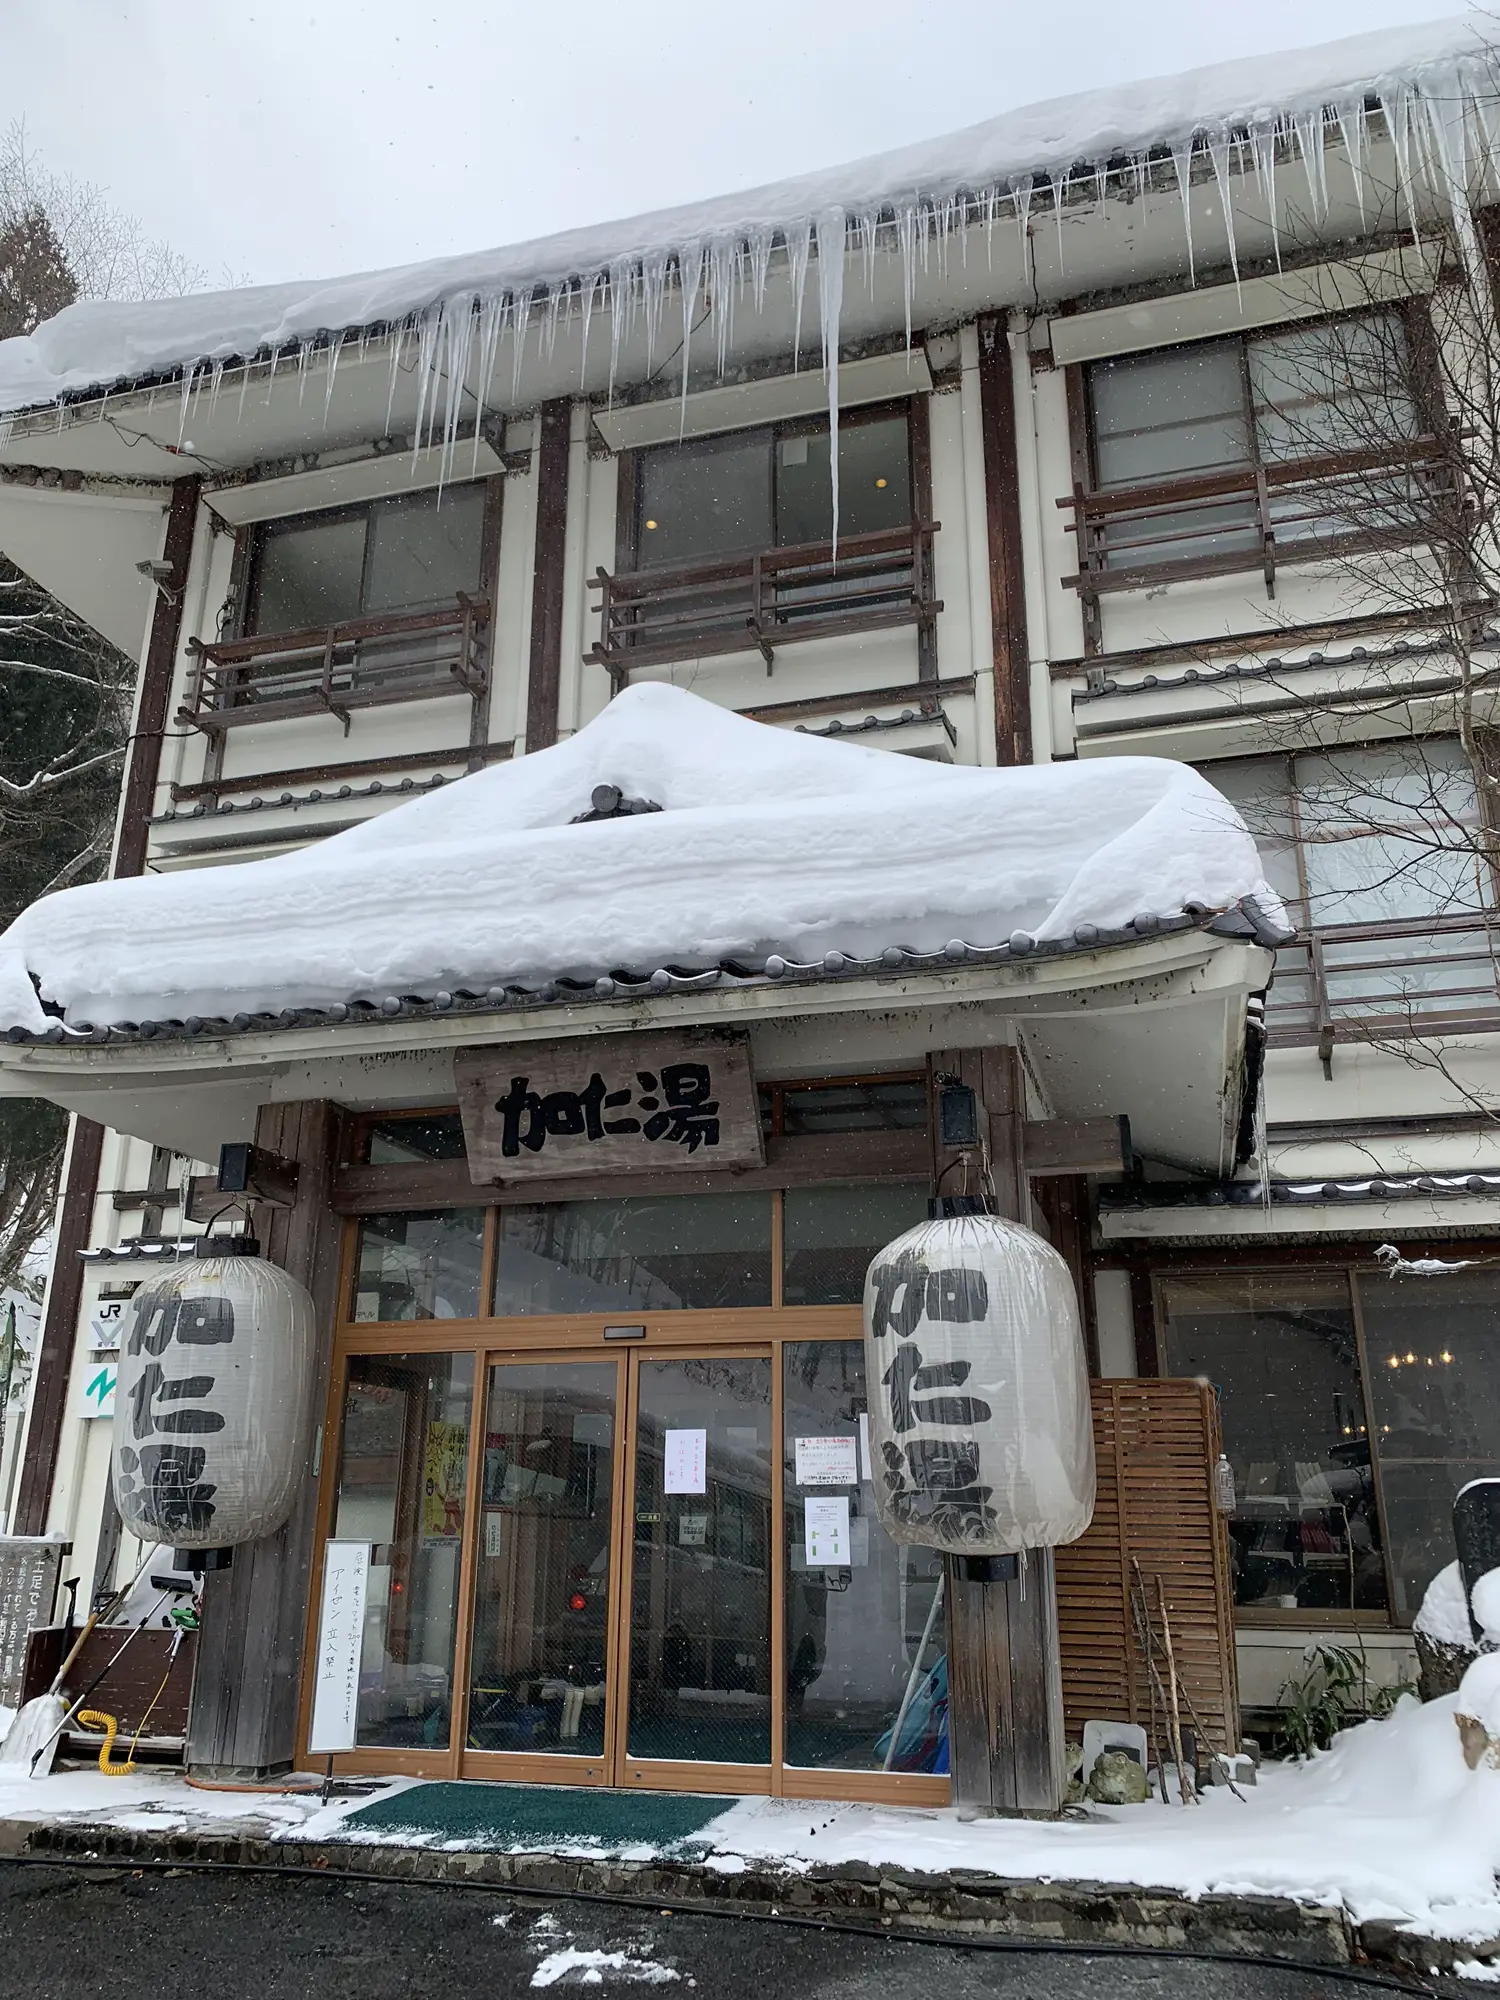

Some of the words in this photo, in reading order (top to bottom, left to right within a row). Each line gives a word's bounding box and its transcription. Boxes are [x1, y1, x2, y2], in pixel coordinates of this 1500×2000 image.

[495, 1063, 720, 1157] 加仁湯
[100, 1304, 120, 1318] JR
[120, 1283, 235, 1534] 加仁湯
[871, 1250, 998, 1541] 加仁湯
[330, 1568, 346, 1620] アイゼン
[322, 1627, 339, 1680] 立入禁止
